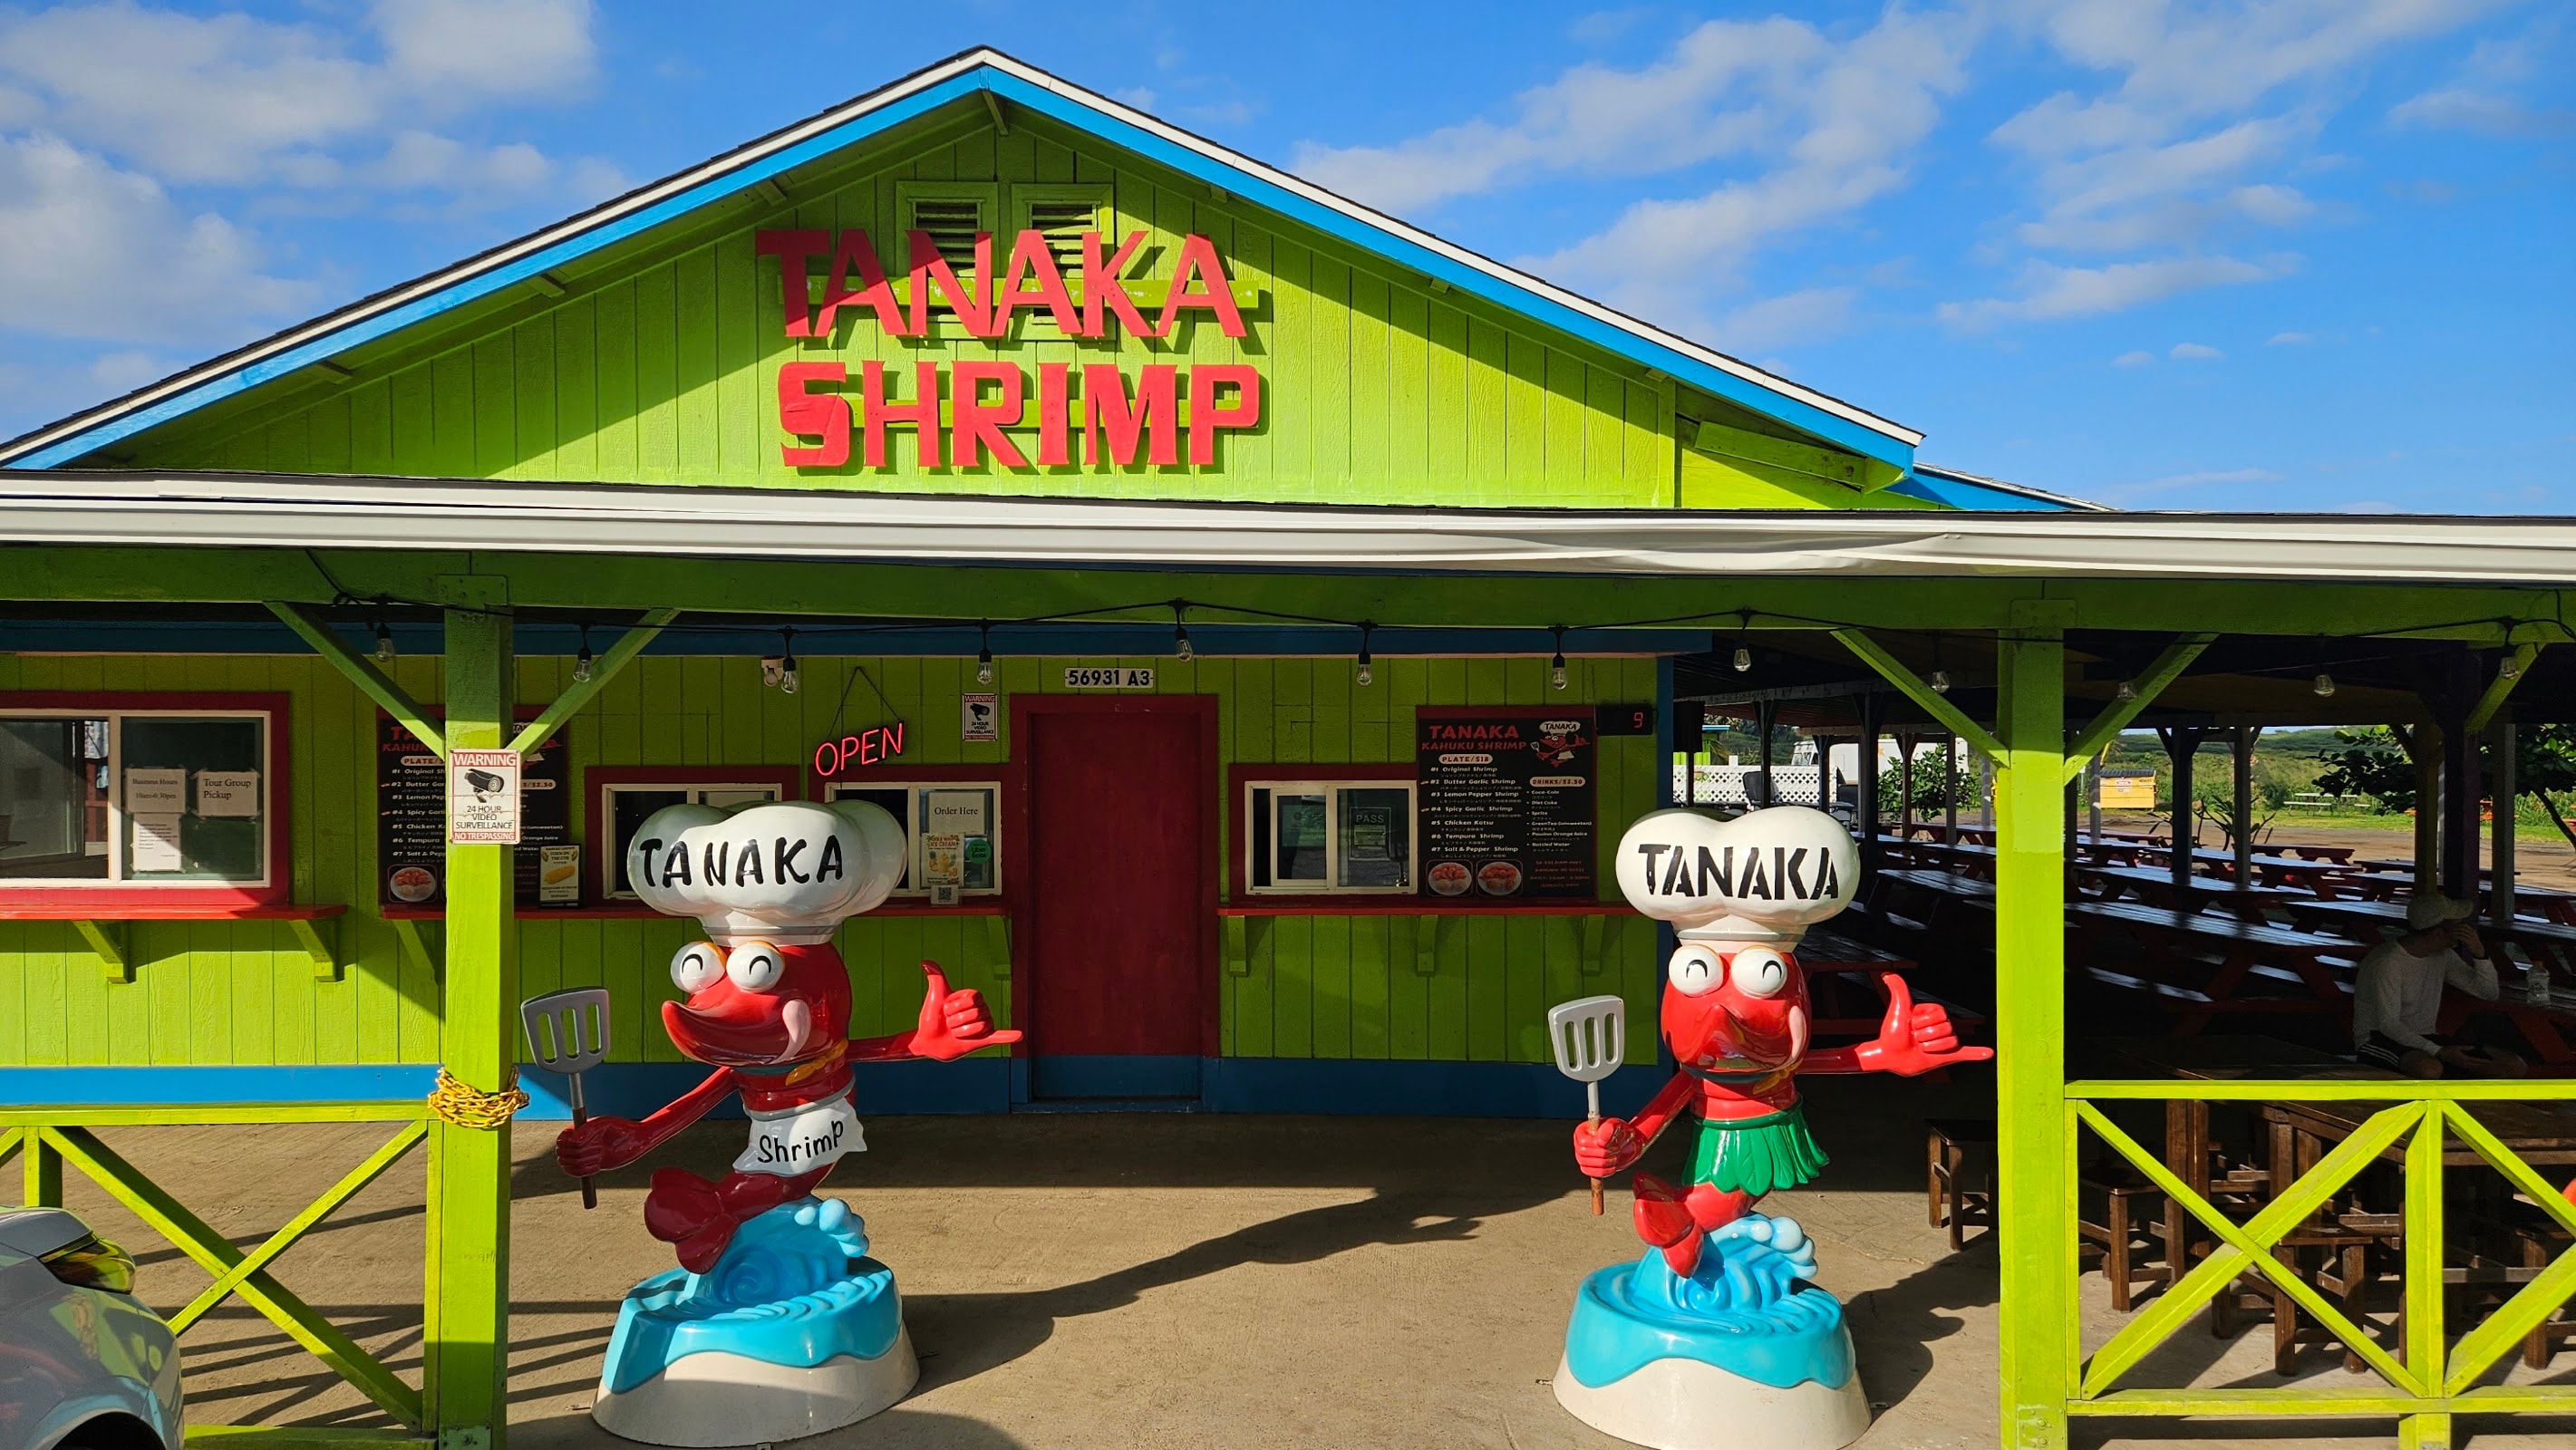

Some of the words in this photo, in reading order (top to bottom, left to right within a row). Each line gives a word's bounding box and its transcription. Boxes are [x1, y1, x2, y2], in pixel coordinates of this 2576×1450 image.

[755, 228, 1247, 337] TANAKA
[778, 360, 1260, 467] SHRIMP
[1069, 670, 1120, 686] 56931
[1128, 671, 1150, 686] A3
[1633, 712, 1643, 728] 9
[1429, 725, 1519, 739] TANAKA
[382, 742, 430, 752] KAHUK
[816, 722, 904, 777] OPEN
[1421, 741, 1475, 750] KAHUKU
[1477, 741, 1527, 750] SHRIMP
[453, 753, 517, 766] WARNING
[203, 778, 222, 787] Tour
[224, 778, 252, 788] Group
[203, 791, 232, 800] Pickup
[935, 807, 958, 815] Order
[960, 807, 978, 815] Here
[455, 821, 513, 829] SURVEILLANCE
[1356, 815, 1385, 823] PASS
[640, 835, 844, 888] TANAKA
[1638, 844, 1839, 900] TANAKA
[758, 1120, 844, 1164] Shrimp
